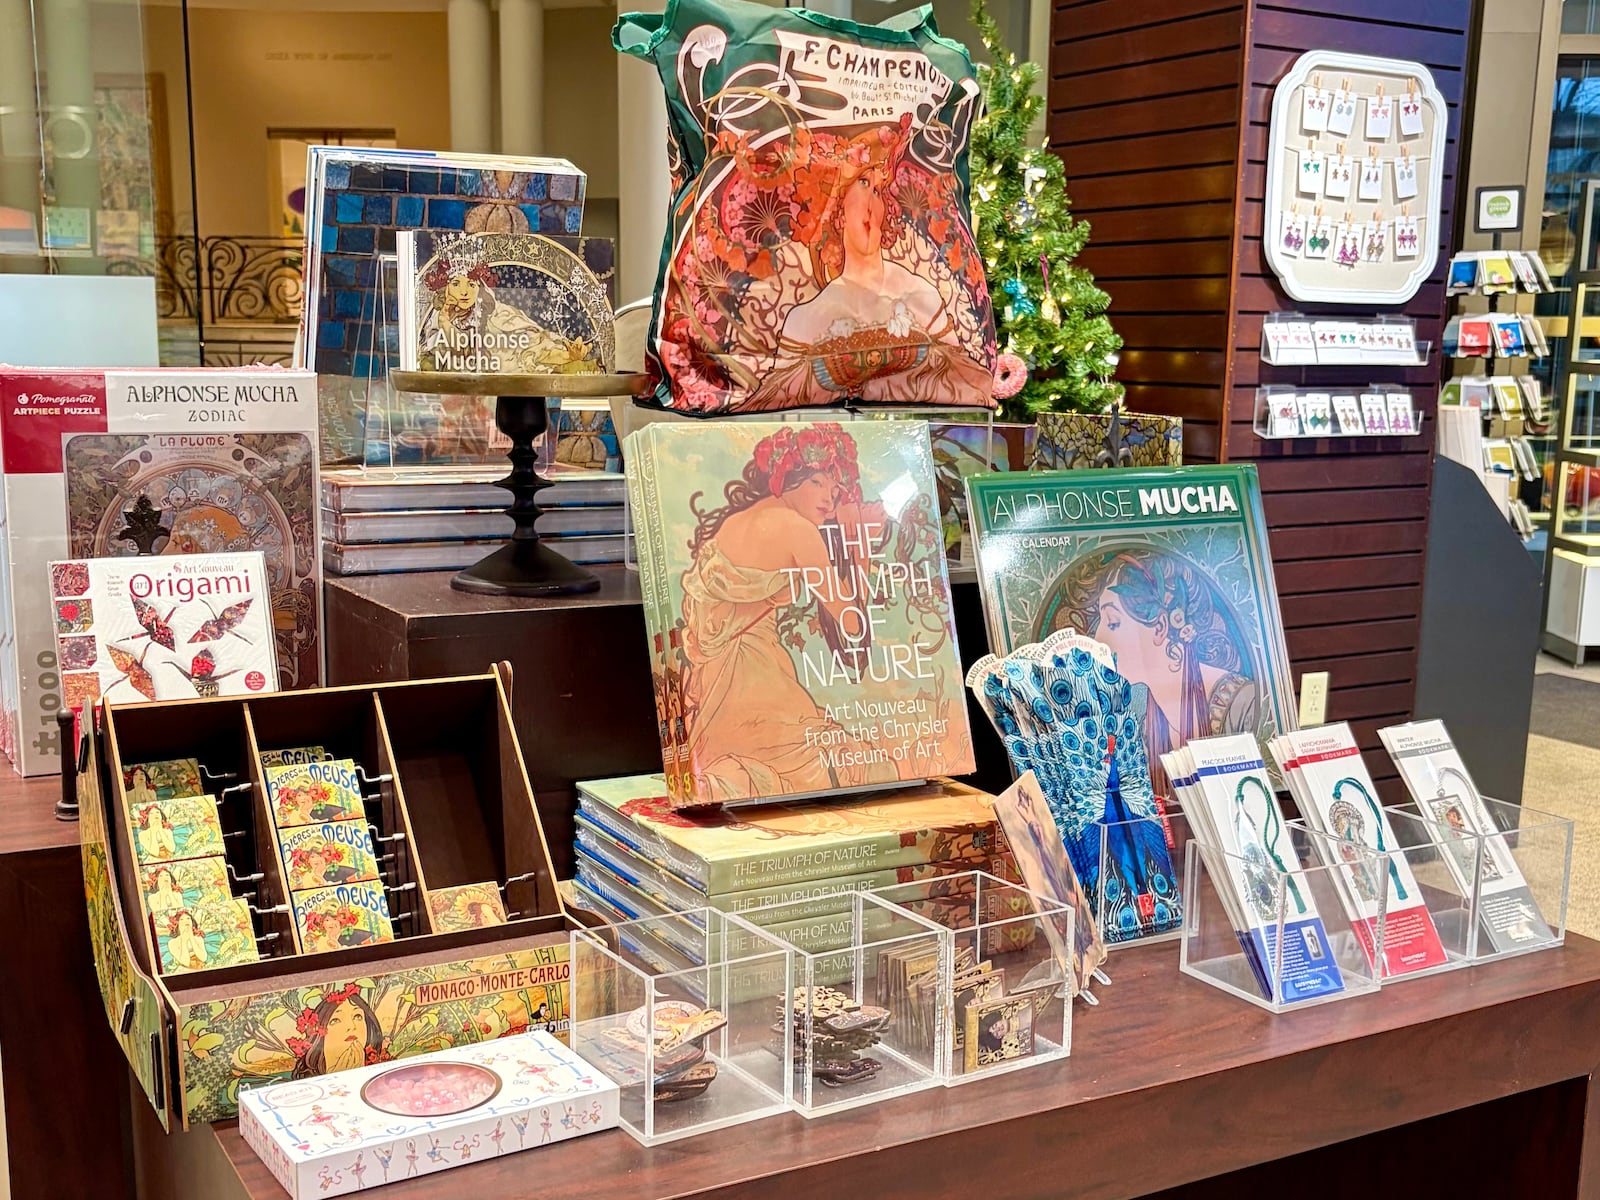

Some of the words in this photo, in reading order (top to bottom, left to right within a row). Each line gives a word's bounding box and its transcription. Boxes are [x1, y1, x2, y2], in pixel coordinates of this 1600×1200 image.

[804, 41, 820, 64] F.
[853, 106, 894, 120] PARIS
[434, 328, 530, 350] Alphonse
[435, 350, 501, 371] Mucha
[31, 393, 96, 406] Pomegranate
[127, 385, 230, 403] ALPHONSE
[234, 386, 299, 406] MUCHA
[13, 407, 60, 415] ARTPIECE
[64, 407, 101, 415] PUZZLE
[188, 409, 247, 422] ZODIAC
[159, 437, 176, 447] LA
[180, 436, 225, 447] PLUME
[993, 489, 1135, 524] ALPHONSE
[1137, 485, 1238, 517] MUCHA
[818, 522, 886, 561] THE
[1022, 536, 1072, 549] CALENDAR
[129, 569, 251, 603] Origami
[134, 580, 148, 590] art
[658, 555, 670, 605] NATURE
[780, 560, 933, 605] TRIUMPH
[839, 604, 886, 643] OF
[1038, 636, 1058, 660] GLASSES
[1057, 630, 1073, 641] CASE
[802, 642, 935, 688] NATURE
[37, 650, 62, 726] 1000
[824, 703, 851, 722] Art
[855, 698, 926, 719] Nouveau
[804, 726, 847, 747] from
[851, 723, 879, 743] the
[883, 718, 949, 741] Chrysler
[819, 748, 889, 769] Museum
[893, 743, 911, 761] of
[915, 739, 942, 758] Art
[1320, 750, 1353, 760] BOOKMARK
[1418, 745, 1449, 755] BOOKMARK
[309, 764, 360, 795] MEUSE
[1223, 763, 1257, 773] BOOKMARK
[322, 825, 374, 855] MEUSE
[734, 861, 757, 877] THE
[760, 853, 812, 873] TRIUMPH
[814, 850, 832, 864] OF
[832, 844, 878, 862] NATURE
[733, 879, 744, 887] Art
[745, 875, 774, 886] Nouveau
[774, 872, 791, 881] from
[804, 866, 830, 876] Chrysler
[831, 863, 857, 872] Museum
[336, 886, 389, 918] MEUSE
[774, 909, 791, 919] from
[791, 907, 803, 916] the
[804, 904, 830, 915] Chrysler
[810, 924, 828, 938] OF
[814, 960, 830, 974] OF
